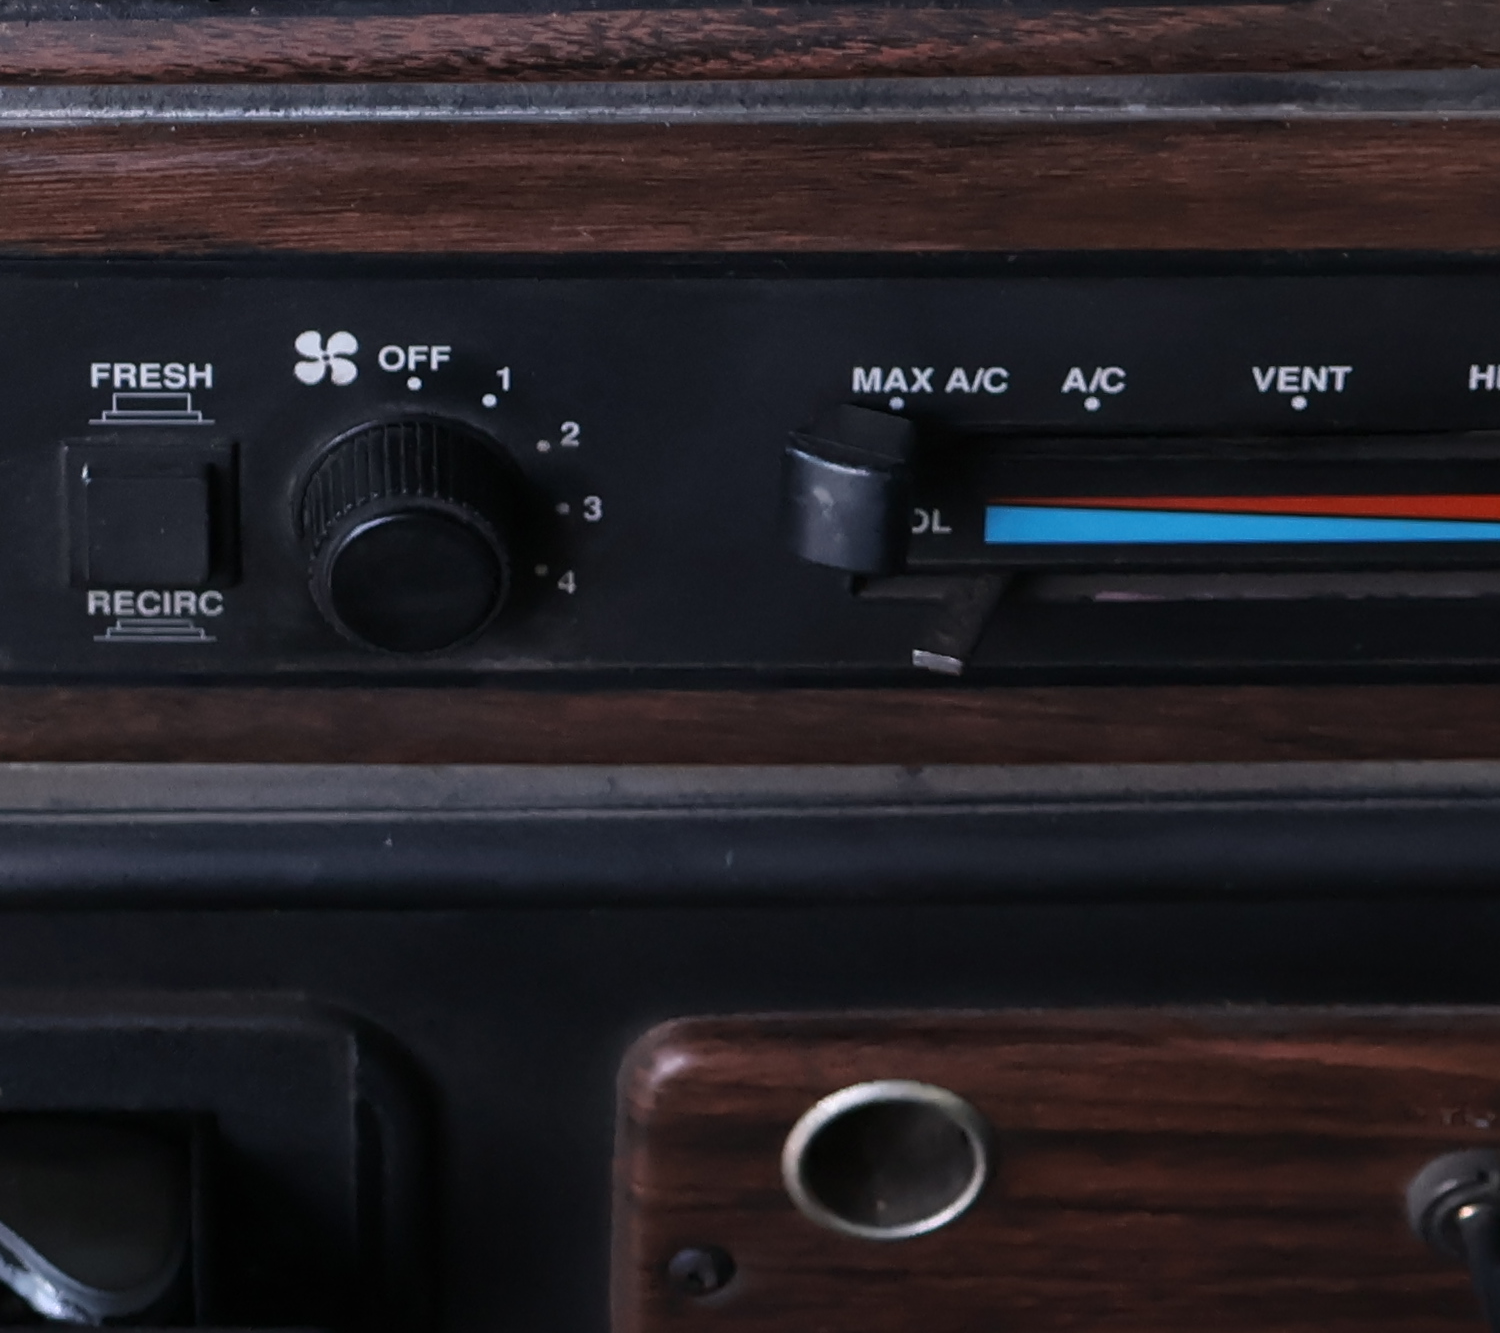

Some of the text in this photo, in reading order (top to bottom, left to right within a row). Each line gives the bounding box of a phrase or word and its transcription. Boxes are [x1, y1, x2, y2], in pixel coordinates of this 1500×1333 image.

[378, 344, 451, 371] OFF
[90, 362, 213, 389] FRESH
[496, 367, 511, 391] 1
[852, 367, 1010, 394] MAX A/C
[1061, 366, 1126, 394] A/C
[1252, 366, 1353, 392] VENT
[559, 421, 580, 447] 2
[582, 496, 602, 521] 3
[557, 570, 576, 595] 4
[87, 590, 224, 617] RECIRC
